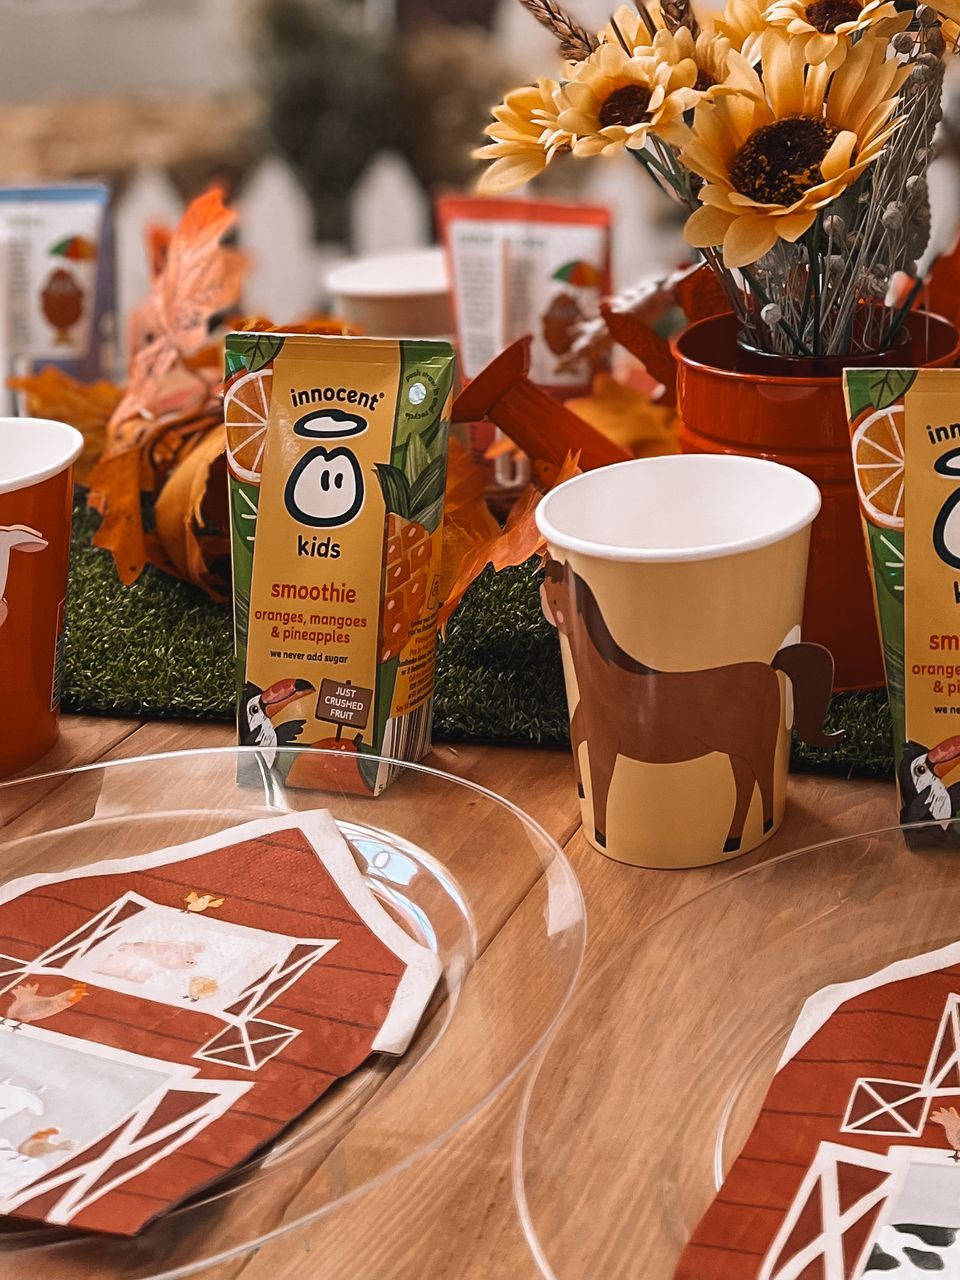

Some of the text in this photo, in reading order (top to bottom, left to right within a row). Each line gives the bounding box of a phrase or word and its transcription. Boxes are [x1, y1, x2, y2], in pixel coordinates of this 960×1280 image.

[291, 387, 380, 411] innocent
[298, 534, 341, 559] kids
[271, 582, 356, 603] smoothie
[255, 610, 367, 629] oranges, mangoes
[271, 626, 350, 645] & pineapples
[270, 650, 348, 664] we never add sugar
[335, 686, 357, 698] JUST
[933, 680, 943, 693] &
[324, 695, 364, 711] CRUSHED
[934, 706, 947, 714] we
[330, 708, 354, 721] FRUIT
